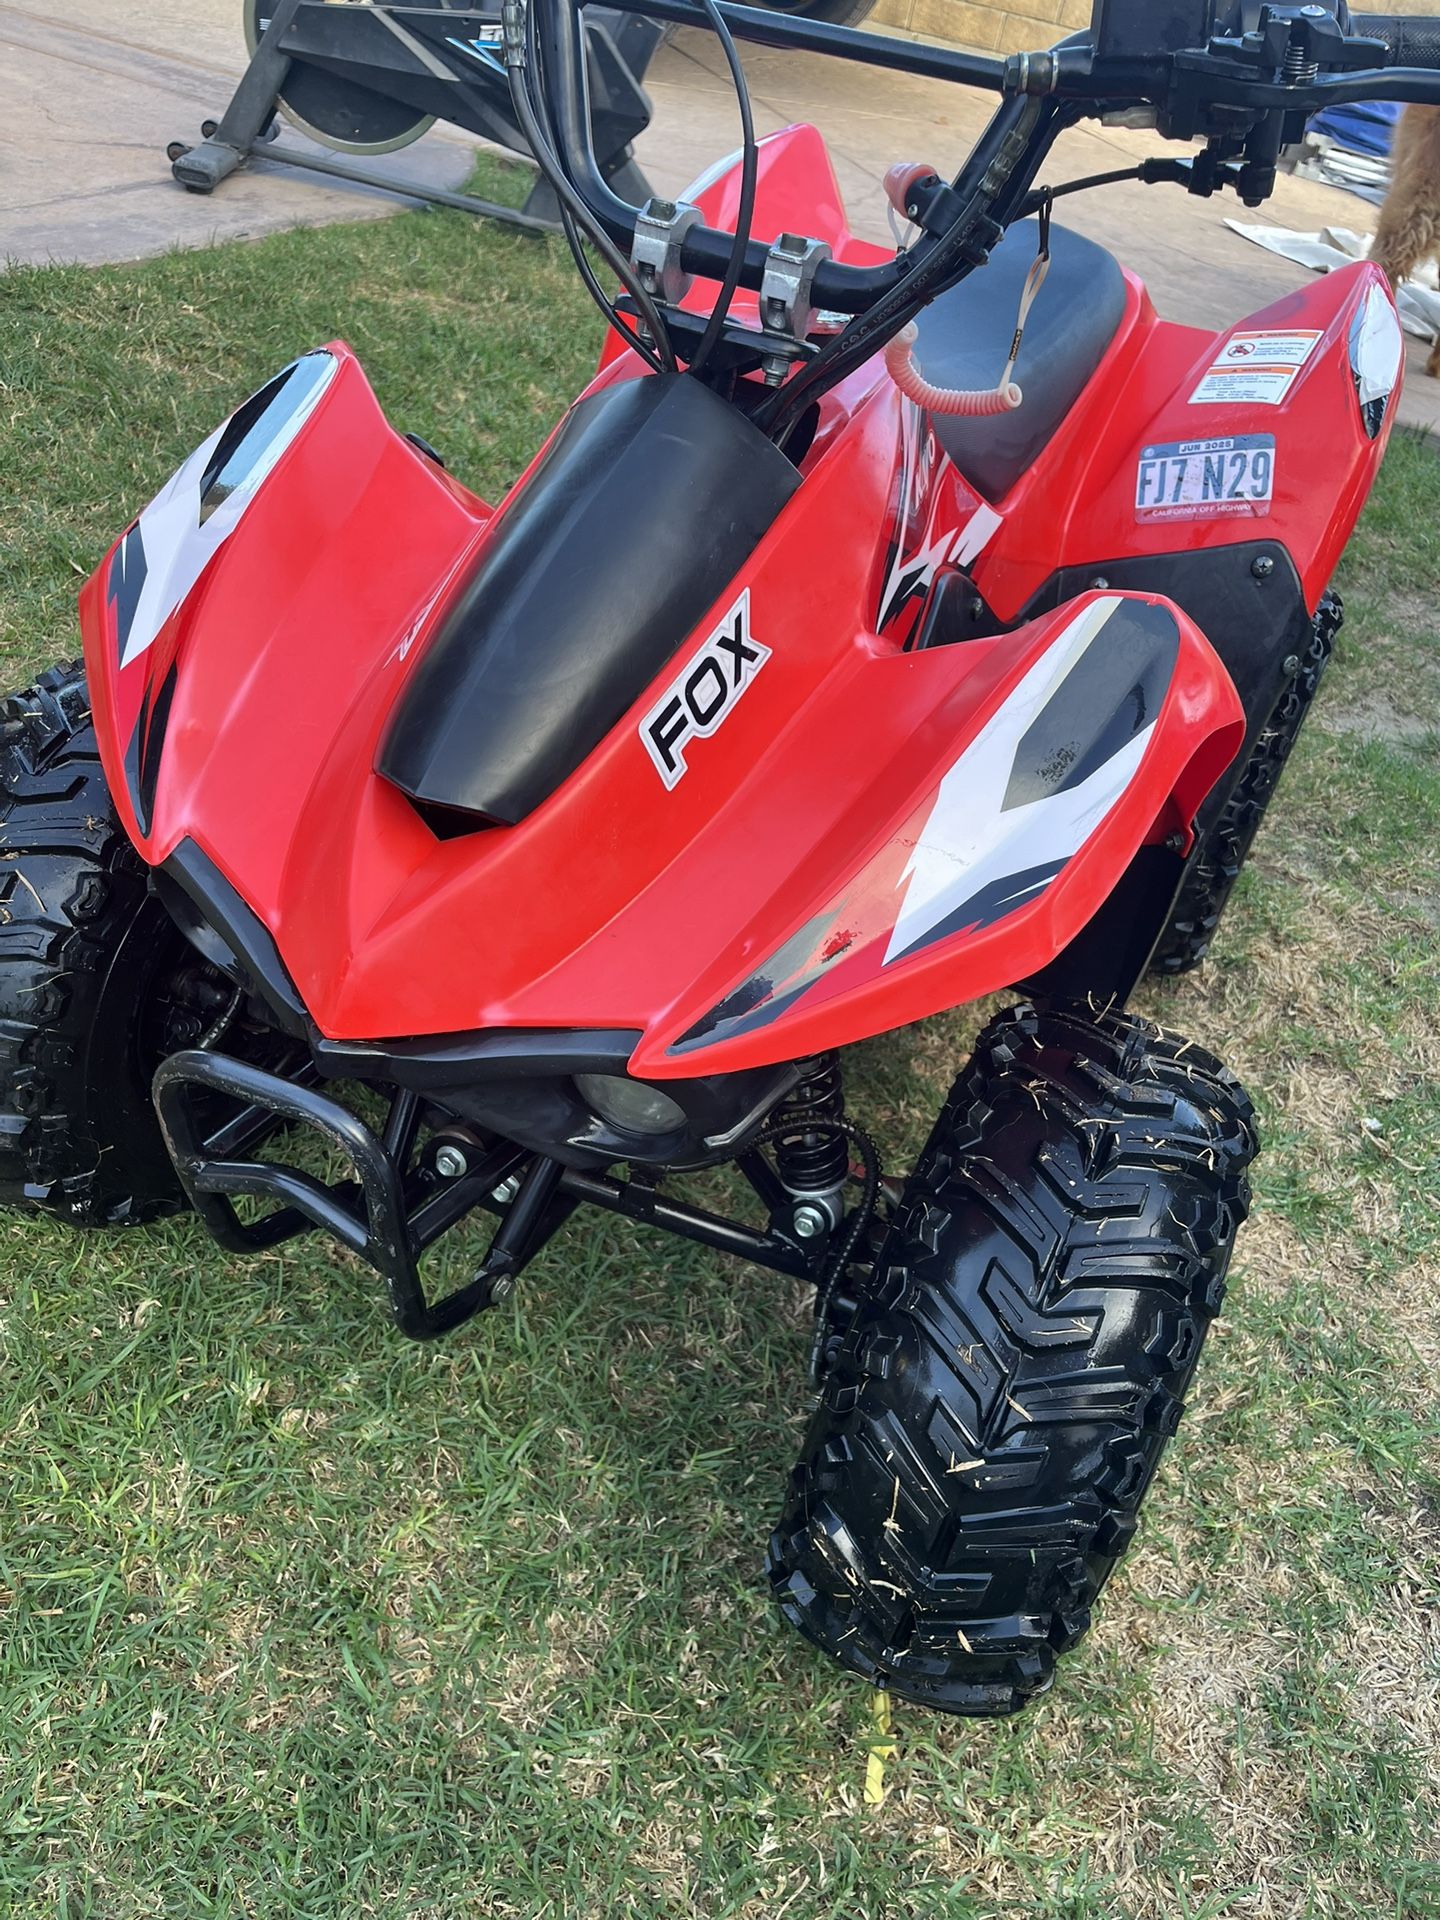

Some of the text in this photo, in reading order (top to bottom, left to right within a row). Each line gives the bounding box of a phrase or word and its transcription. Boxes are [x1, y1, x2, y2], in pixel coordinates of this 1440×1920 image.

[1181, 441, 1232, 452] JUN 2025
[1138, 451, 1271, 506] FJ7 N29
[1152, 502, 1251, 518] CALIFORNIA OFF HIGHWAY
[645, 604, 763, 777] FOX
